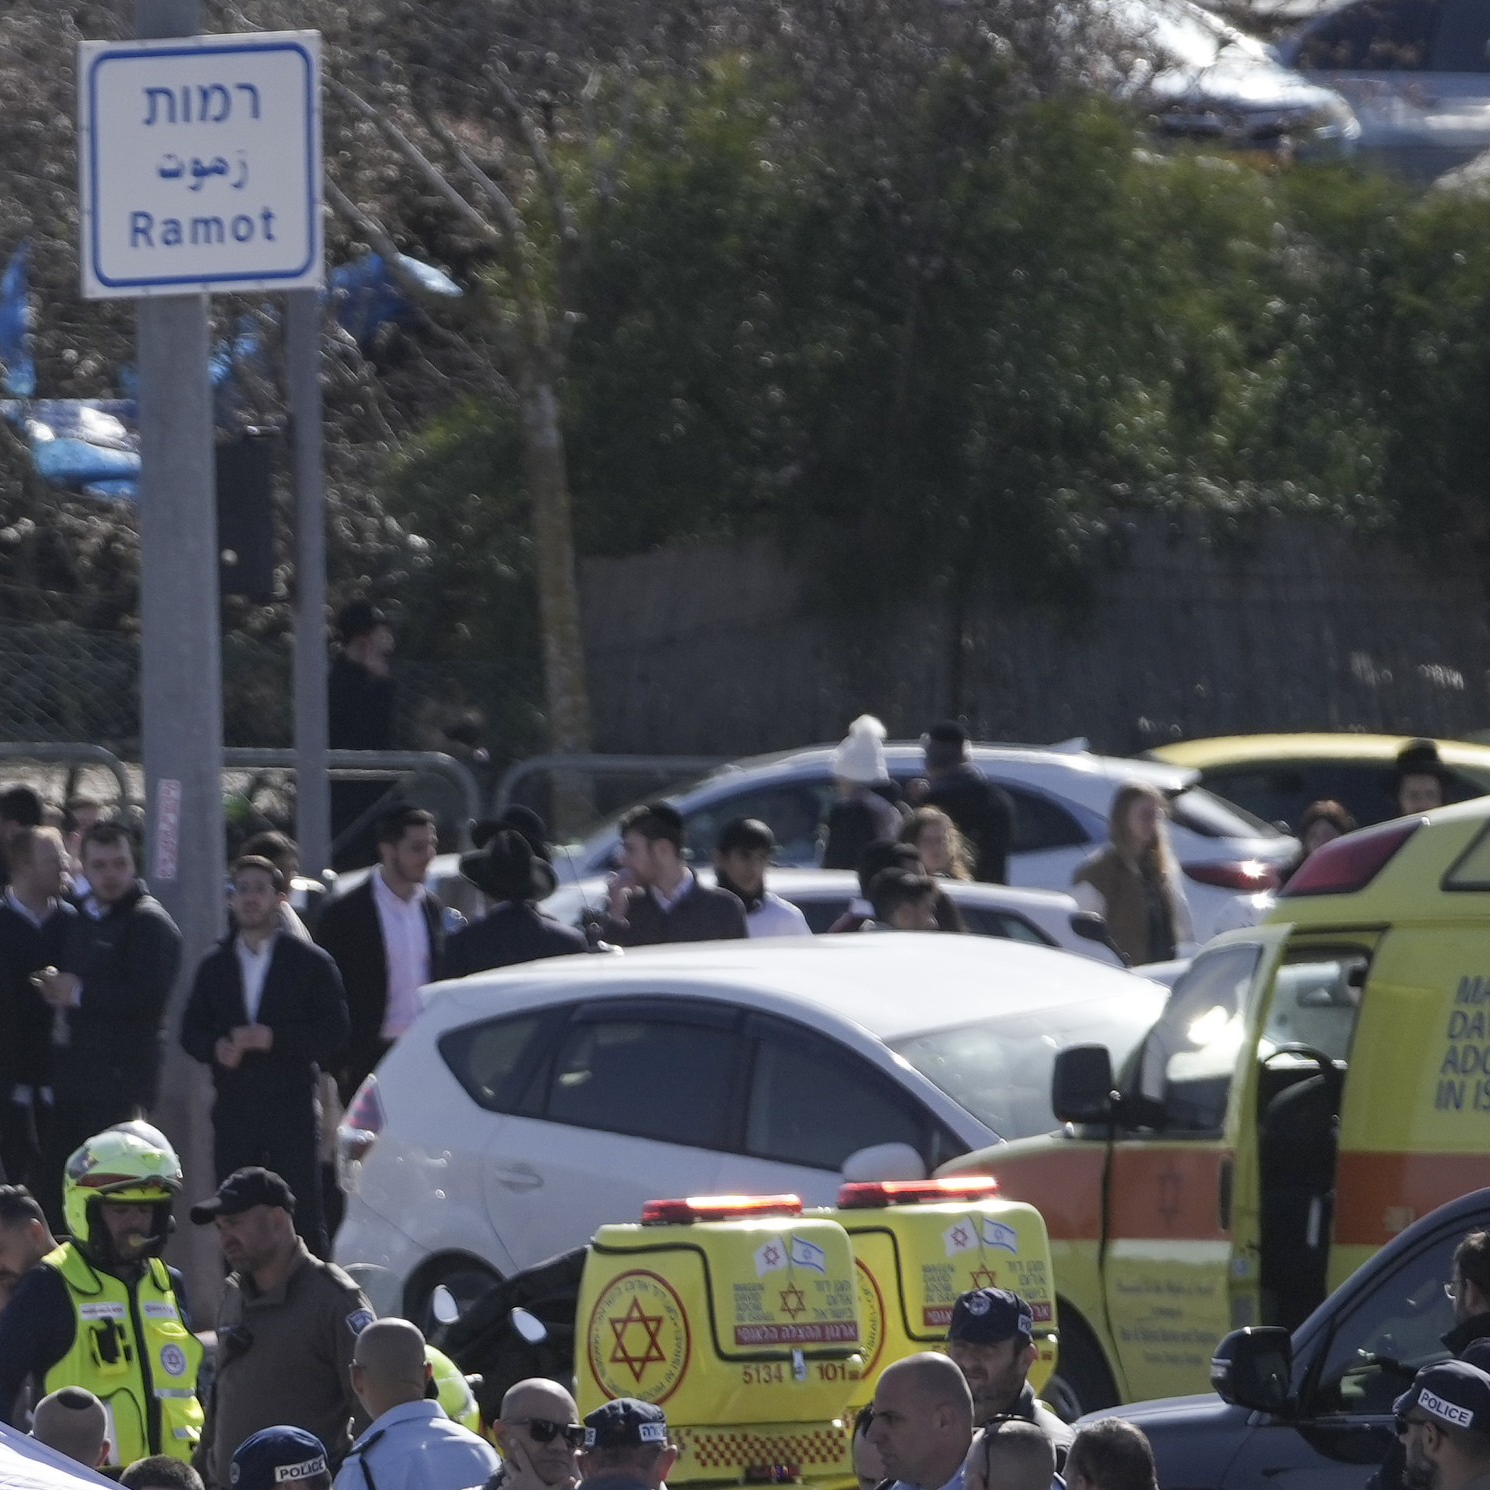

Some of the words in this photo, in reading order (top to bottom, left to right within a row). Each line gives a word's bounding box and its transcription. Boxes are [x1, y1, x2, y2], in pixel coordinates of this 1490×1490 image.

[142, 82, 261, 126] רמות
[129, 206, 276, 248] Ramot
[742, 1365, 783, 1385] 5134
[1420, 1391, 1470, 1424] POLICE
[280, 1460, 324, 1479] POLICE
